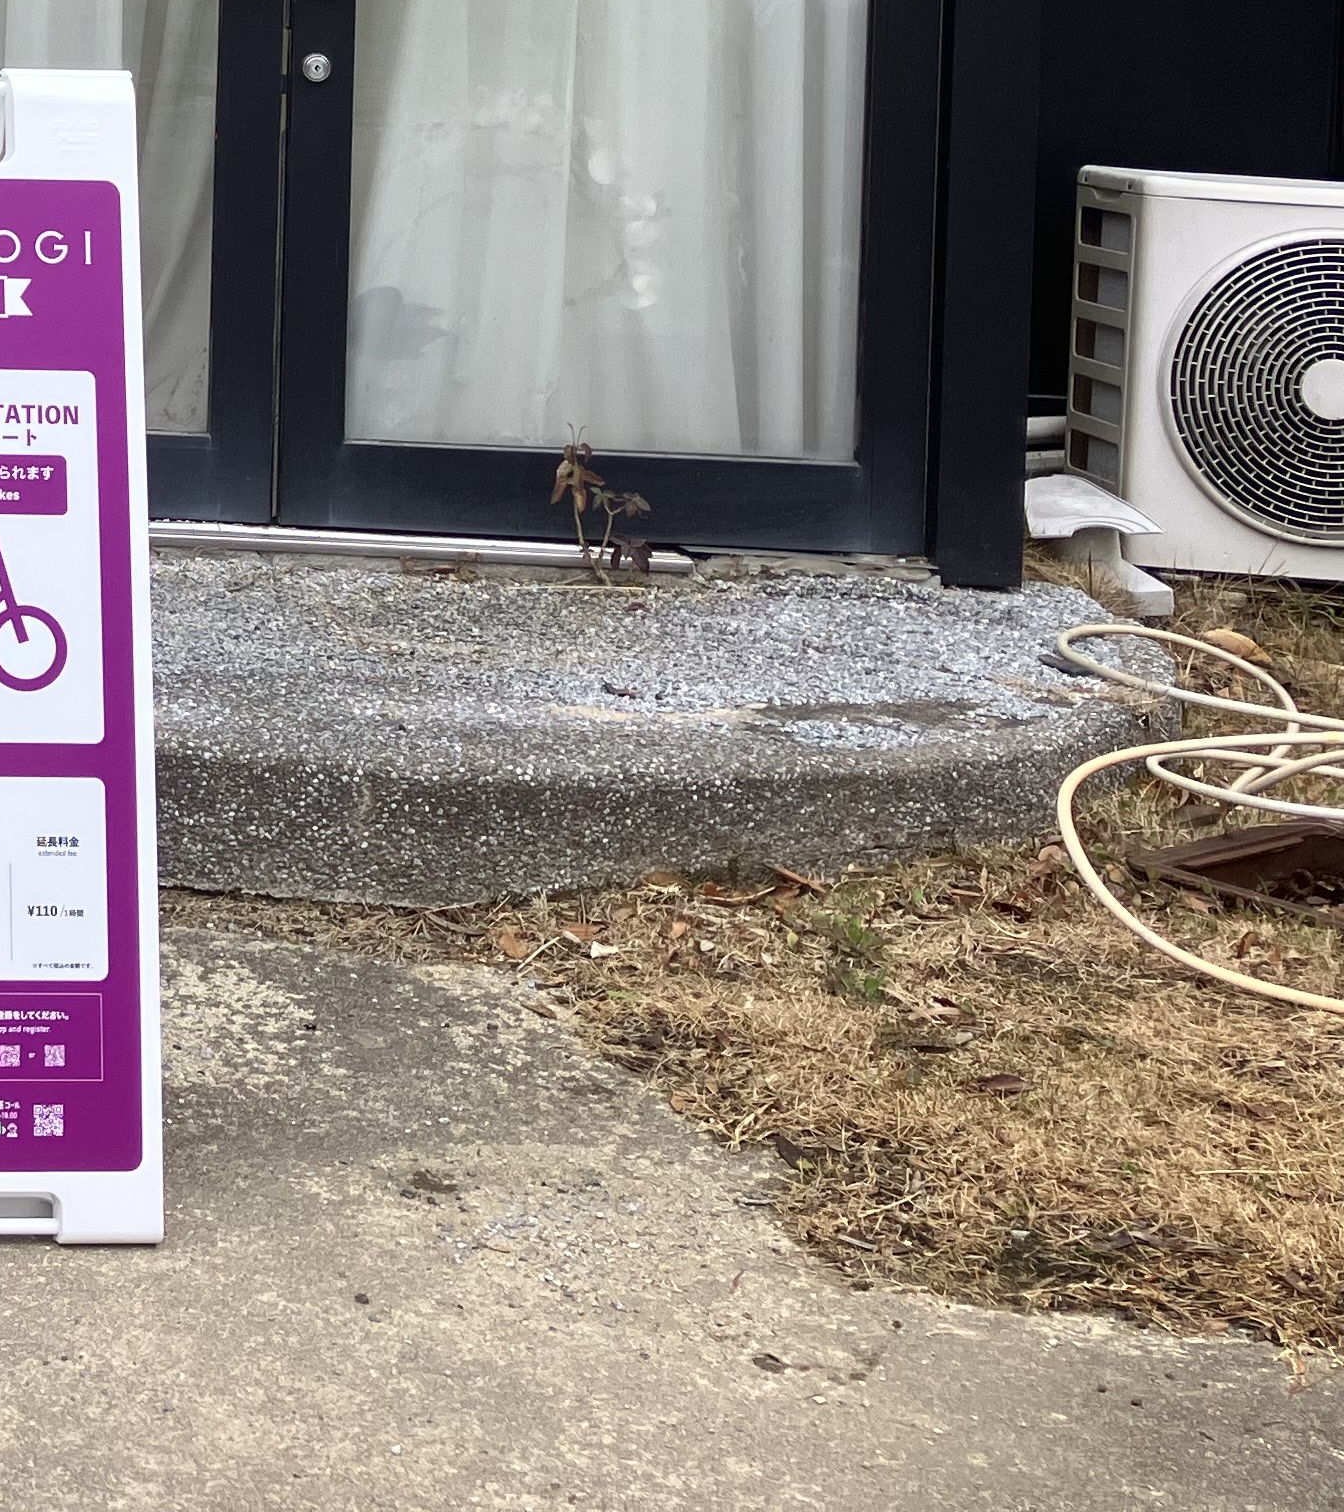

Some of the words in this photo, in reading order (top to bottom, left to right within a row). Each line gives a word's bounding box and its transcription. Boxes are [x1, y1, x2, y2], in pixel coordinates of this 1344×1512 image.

[36, 836, 80, 848] 延長料金
[8, 1024, 21, 1033] and
